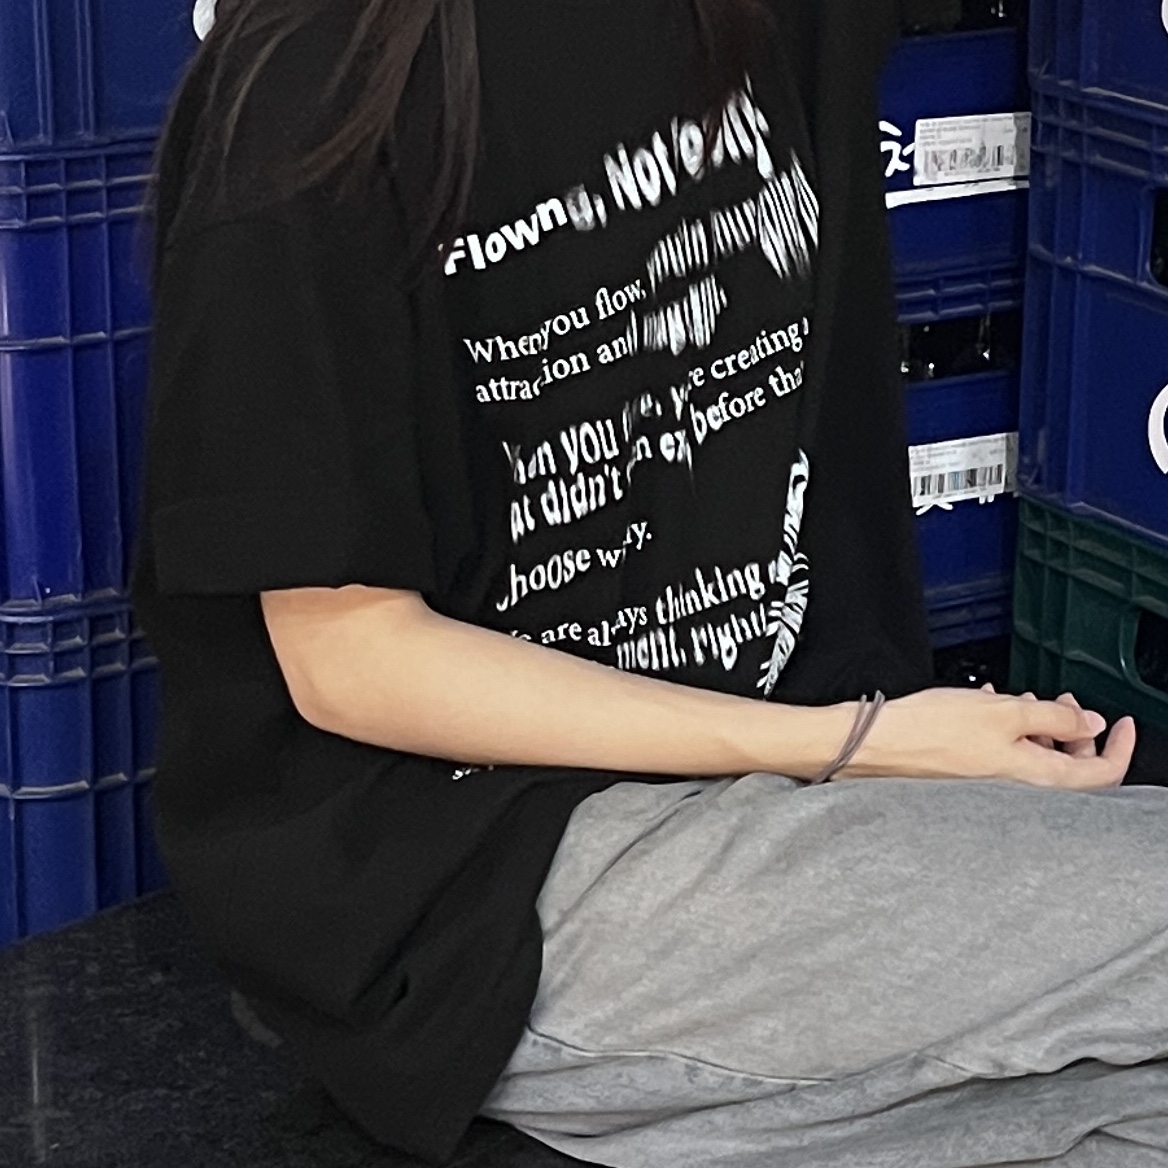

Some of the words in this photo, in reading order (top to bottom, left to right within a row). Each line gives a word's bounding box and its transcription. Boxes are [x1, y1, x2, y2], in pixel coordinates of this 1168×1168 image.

[538, 303, 591, 350] you
[560, 418, 620, 475] you
[710, 318, 803, 381] creating
[540, 620, 583, 646] are
[587, 604, 649, 648] alays
[655, 560, 767, 626] thinking
